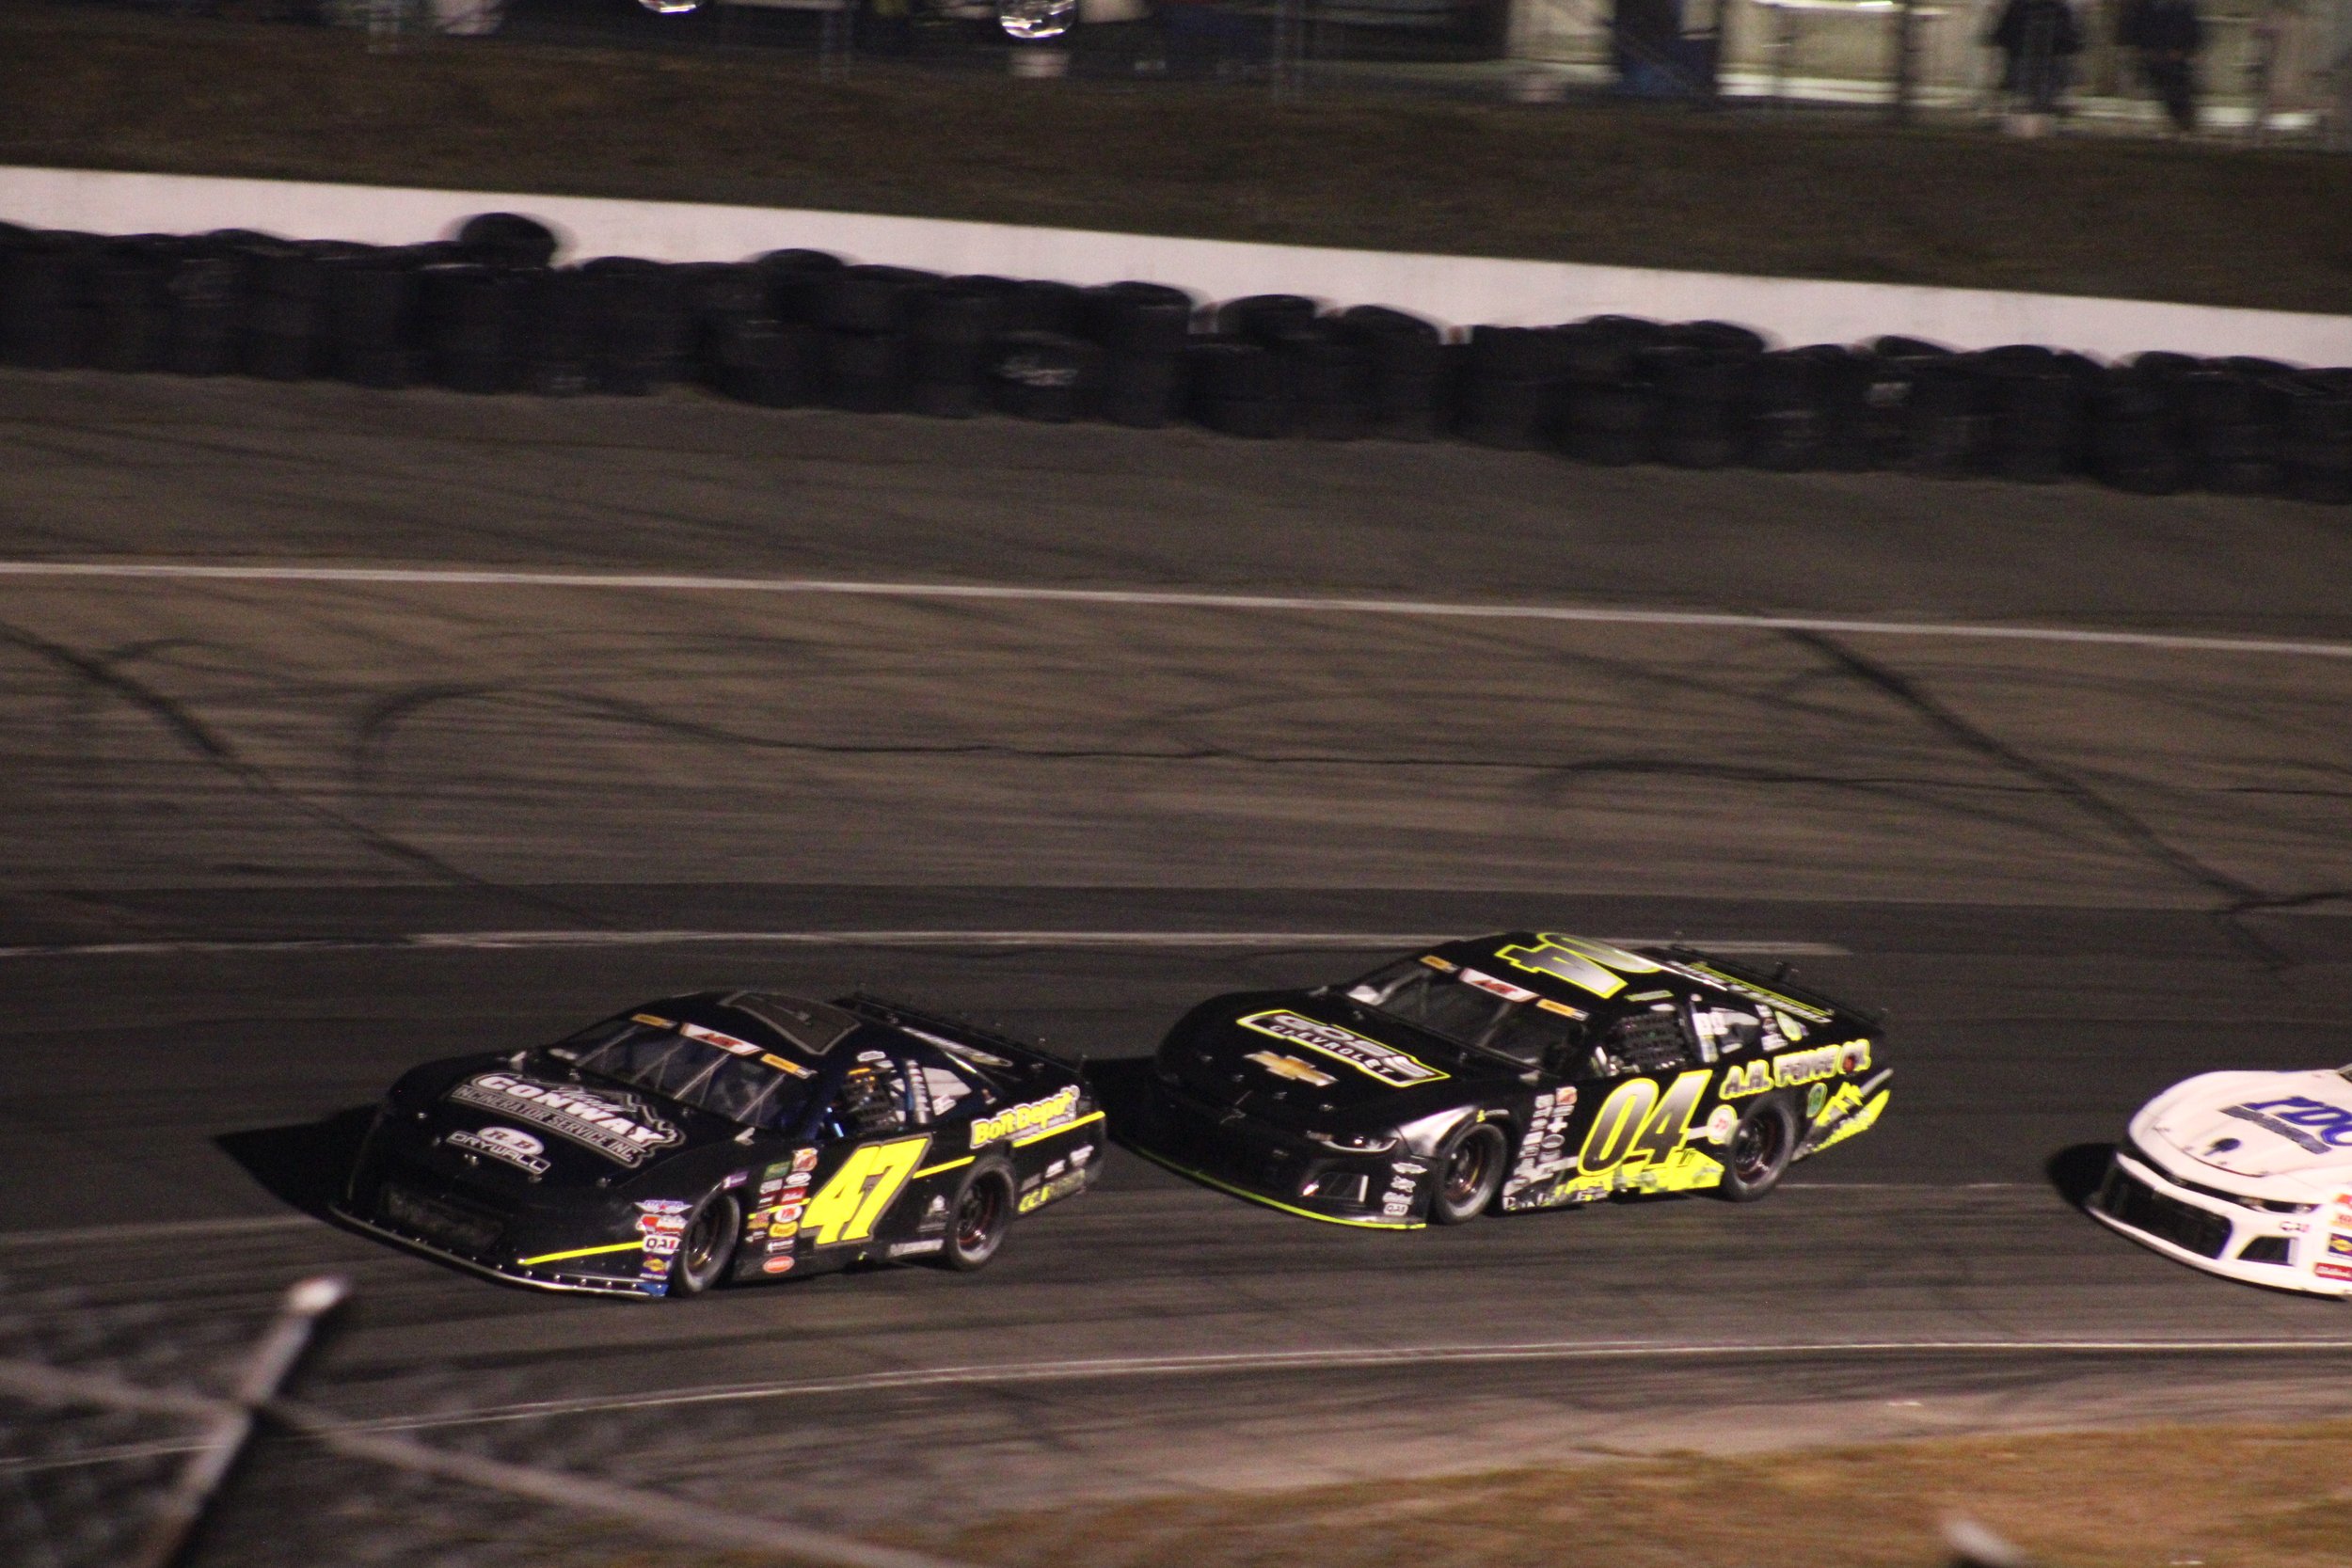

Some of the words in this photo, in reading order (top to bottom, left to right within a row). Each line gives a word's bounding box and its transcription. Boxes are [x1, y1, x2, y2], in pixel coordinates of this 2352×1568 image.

[1269, 1024, 1394, 1075] CHEVROLET
[453, 1086, 548, 1125] INCINERATOR
[547, 1114, 610, 1148] SERVICE
[609, 1140, 636, 1162] INC.
[477, 1075, 666, 1145] CONWAY
[971, 1111, 1016, 1147] Bolt
[1578, 1069, 1714, 1177] 04
[450, 1132, 548, 1172] DRYWALL
[800, 1136, 930, 1246] 47
